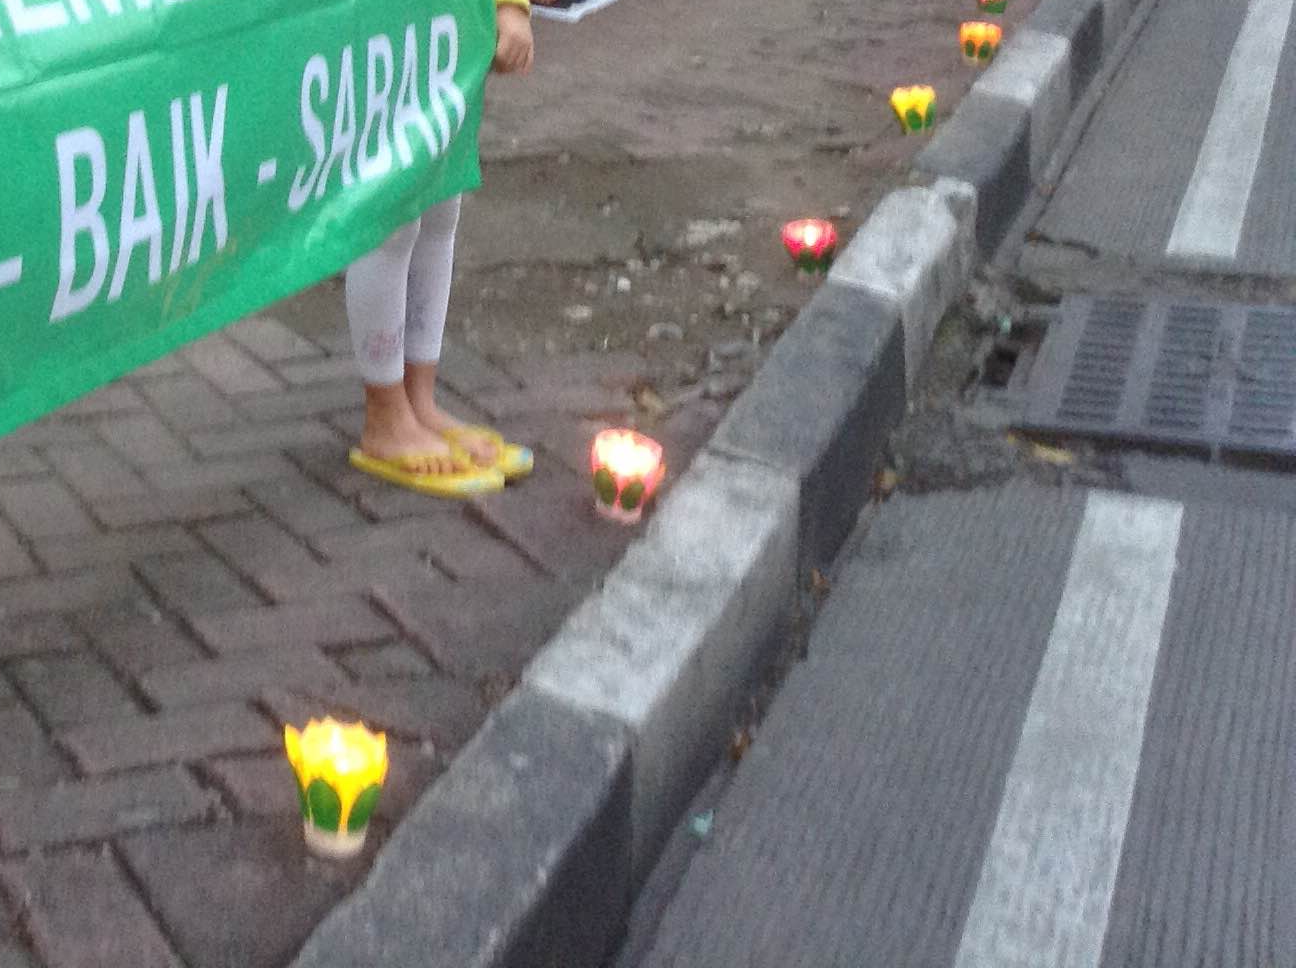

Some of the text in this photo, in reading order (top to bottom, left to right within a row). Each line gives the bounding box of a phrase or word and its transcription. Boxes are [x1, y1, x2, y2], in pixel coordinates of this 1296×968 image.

[48, 83, 229, 325] BAIK
[256, 158, 278, 186] -
[287, 14, 466, 213] SABAR
